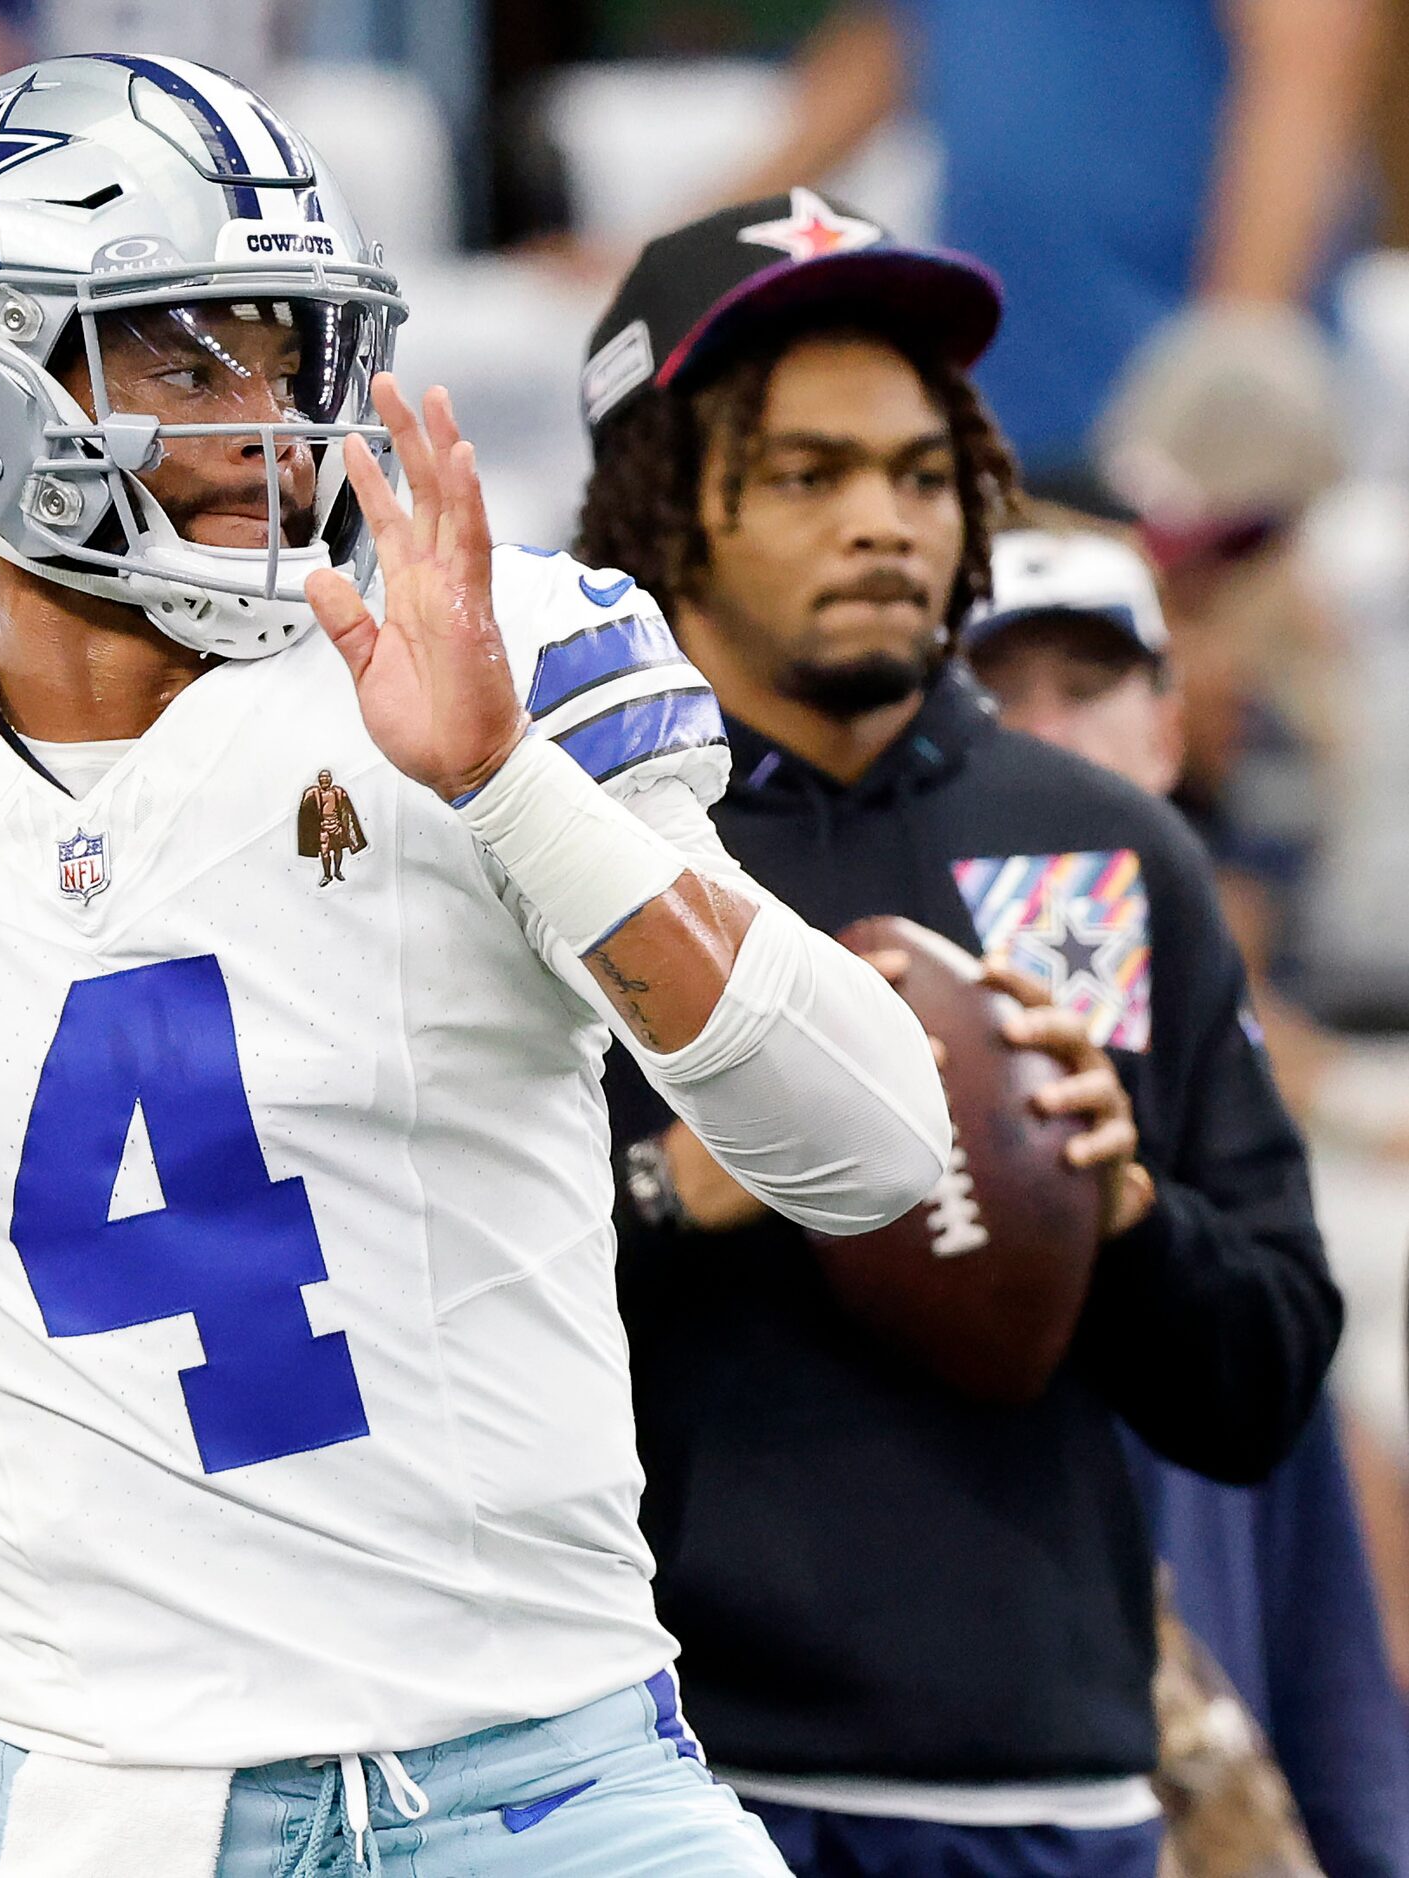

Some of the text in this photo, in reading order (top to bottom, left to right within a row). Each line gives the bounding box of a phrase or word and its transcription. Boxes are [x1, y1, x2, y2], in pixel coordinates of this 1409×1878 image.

[247, 233, 334, 255] COWBOYS
[63, 860, 100, 889] NFL
[9, 953, 370, 1475] 4
